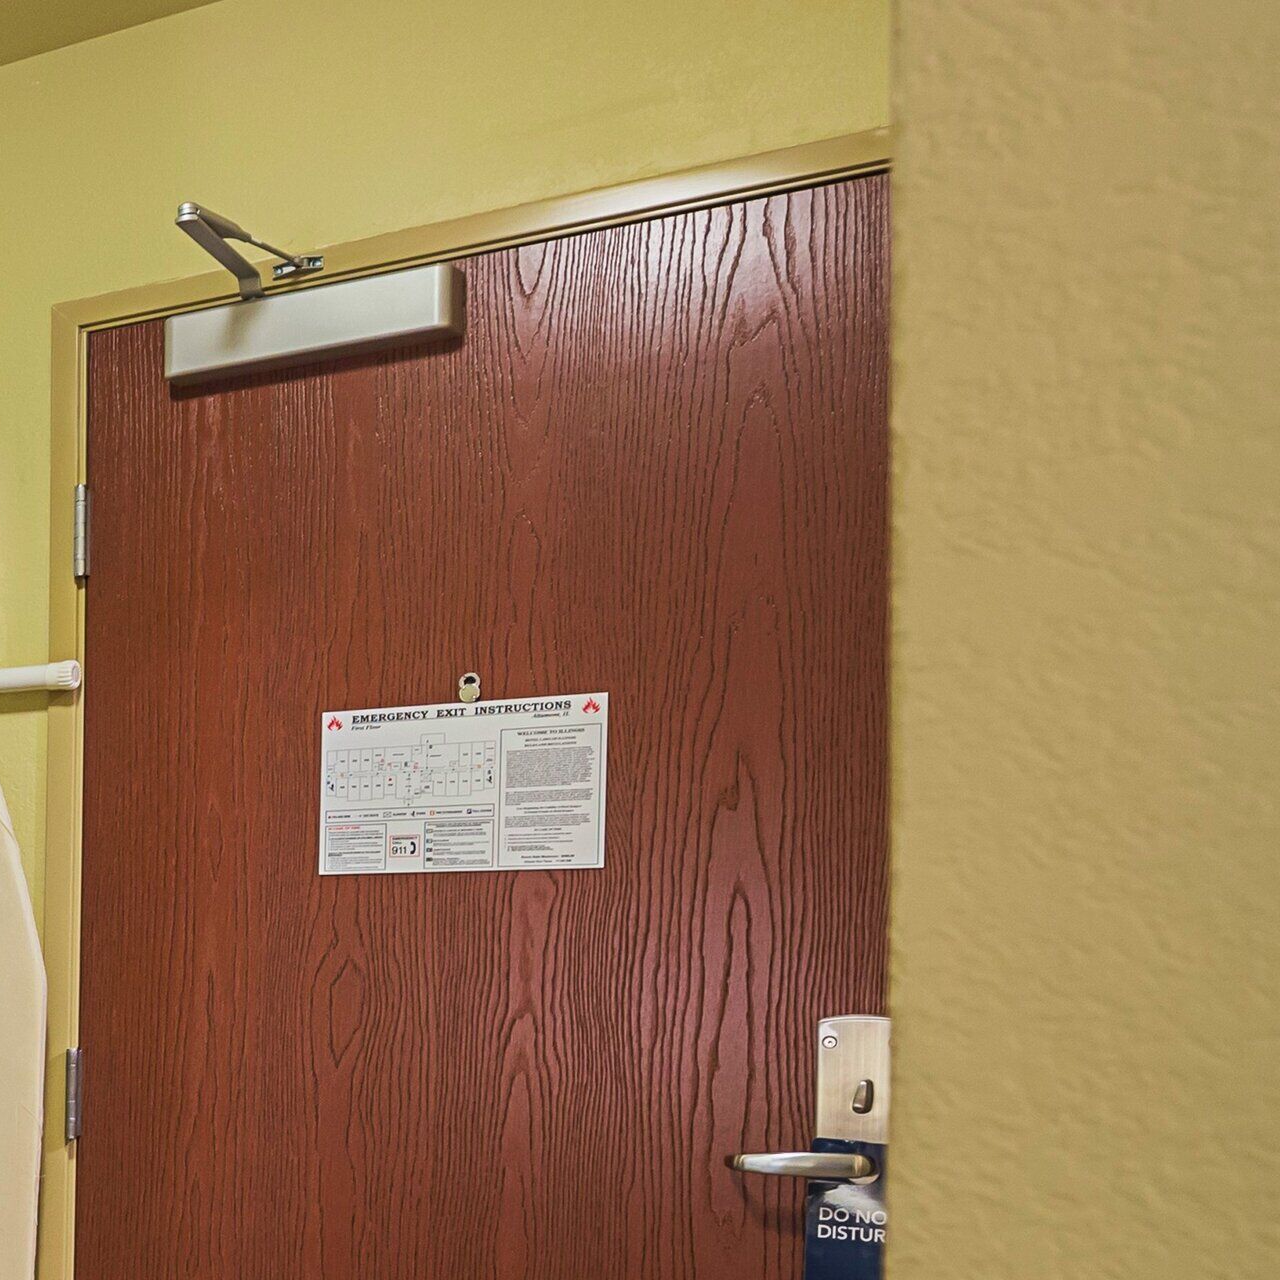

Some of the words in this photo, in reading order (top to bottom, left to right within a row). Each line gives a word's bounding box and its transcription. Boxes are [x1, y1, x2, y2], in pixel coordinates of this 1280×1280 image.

[352, 710, 428, 724] EMERGENCY
[436, 707, 467, 719] EXIT
[474, 700, 572, 717] INSTRUCTIONS
[391, 846, 407, 855] 911
[818, 1206, 850, 1222] DO
[855, 1209, 887, 1225] NO
[817, 1224, 886, 1243] DISTUR
